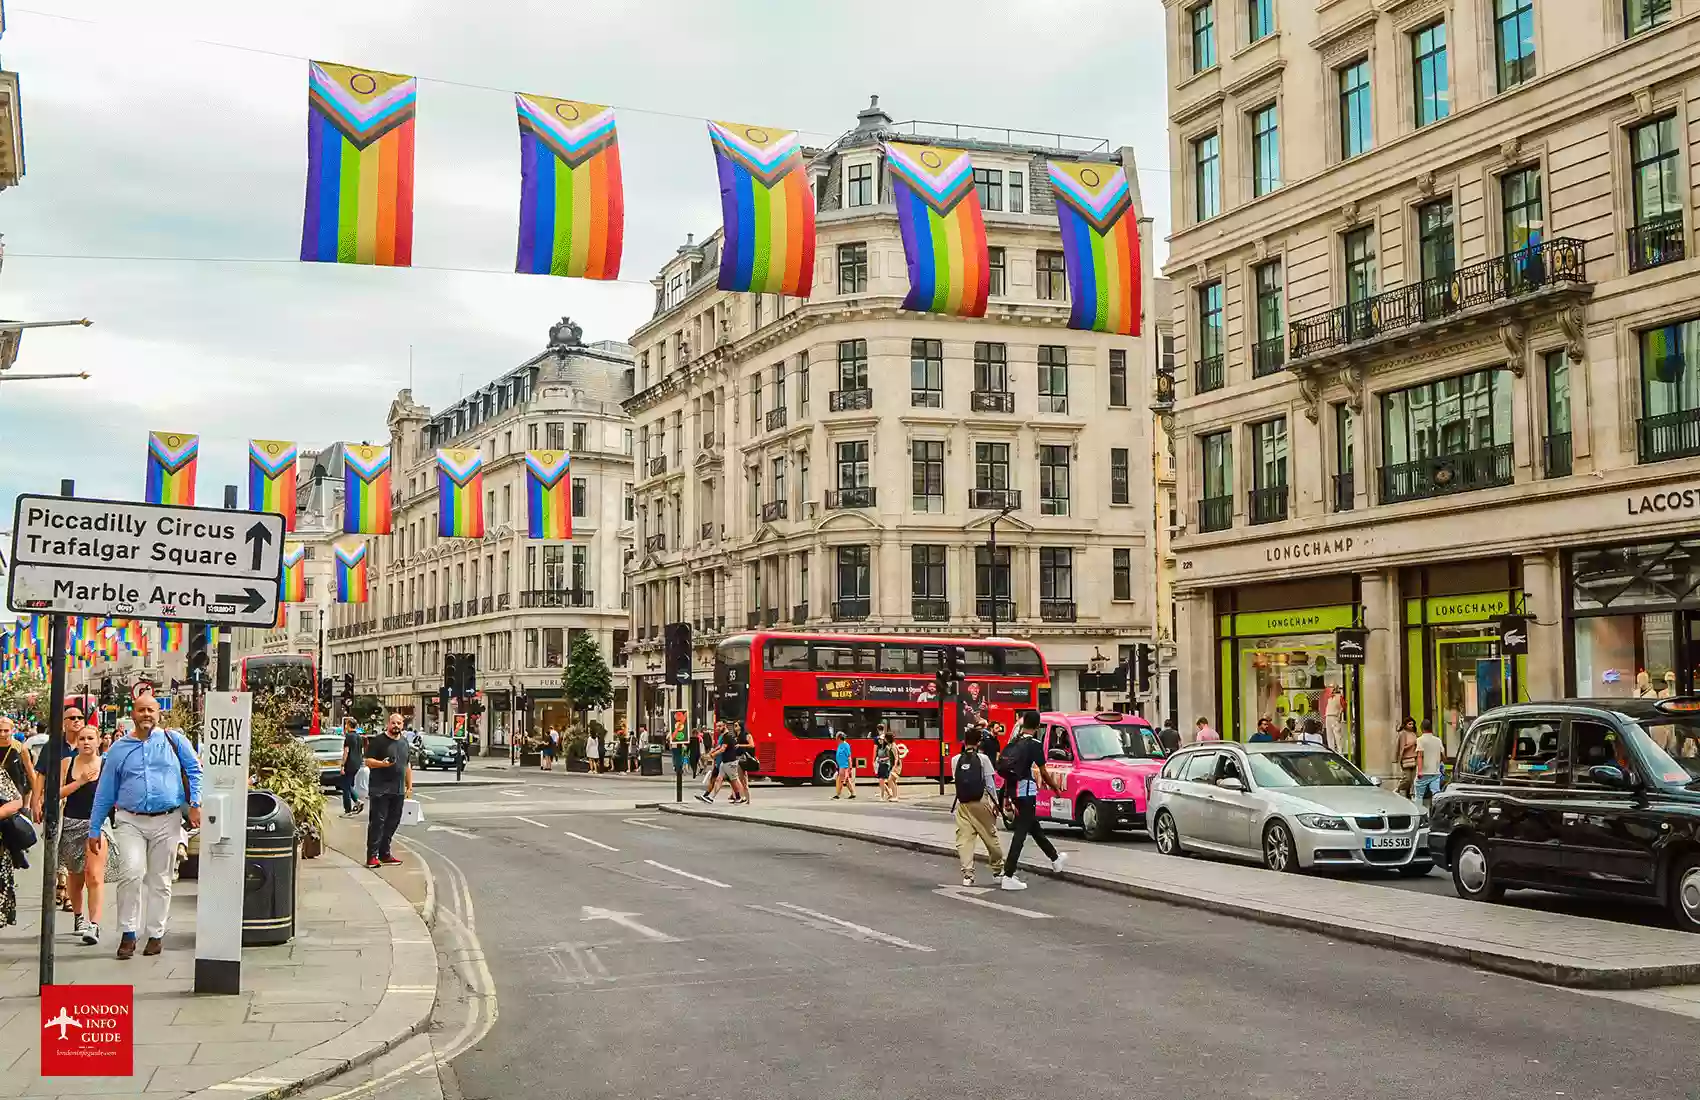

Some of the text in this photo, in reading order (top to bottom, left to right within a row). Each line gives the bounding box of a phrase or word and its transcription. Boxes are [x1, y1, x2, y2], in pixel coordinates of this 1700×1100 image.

[27, 507, 235, 540] Piccadilly Circus
[26, 534, 237, 566] Trafalgar Square
[1266, 538, 1353, 561] LONGCHAMP
[53, 579, 206, 607] Marble Arch
[1436, 601, 1504, 616] LONGCHAMP
[1267, 616, 1320, 628] LONGCHAMP
[869, 685, 897, 694] Mondays
[897, 685, 904, 693] at
[210, 718, 243, 741] STAY
[209, 743, 242, 766] SAFE
[1371, 837, 1411, 848] LJ55 SXB
